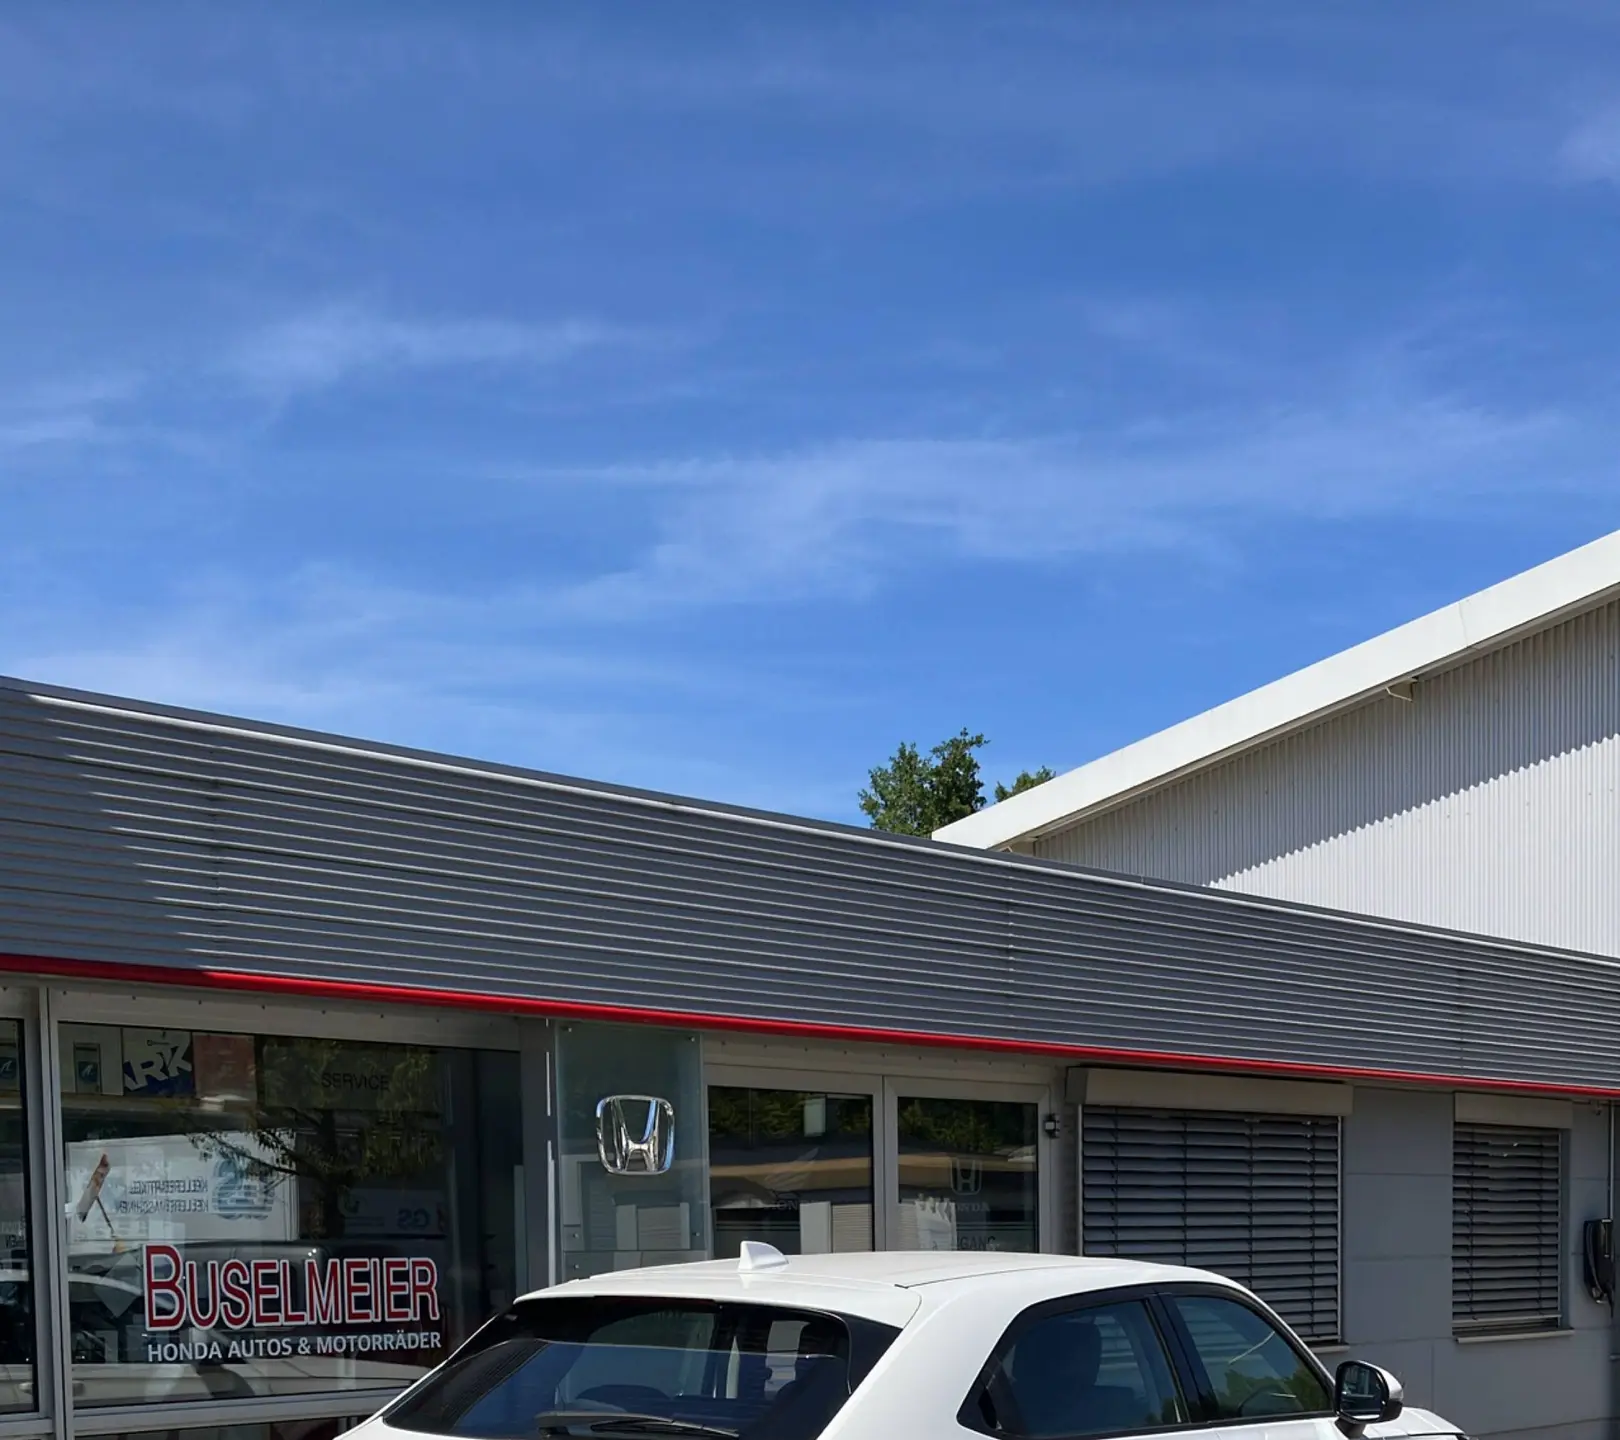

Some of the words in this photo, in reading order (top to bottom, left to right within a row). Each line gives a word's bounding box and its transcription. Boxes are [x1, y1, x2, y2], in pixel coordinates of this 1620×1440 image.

[321, 1073, 390, 1092] SERVICE
[144, 1245, 439, 1330] BUSELMEIER
[148, 1341, 222, 1362] HONDA
[228, 1337, 292, 1358] AUTOS
[297, 1337, 311, 1355] &
[316, 1330, 441, 1354] MOTORRÄDER
